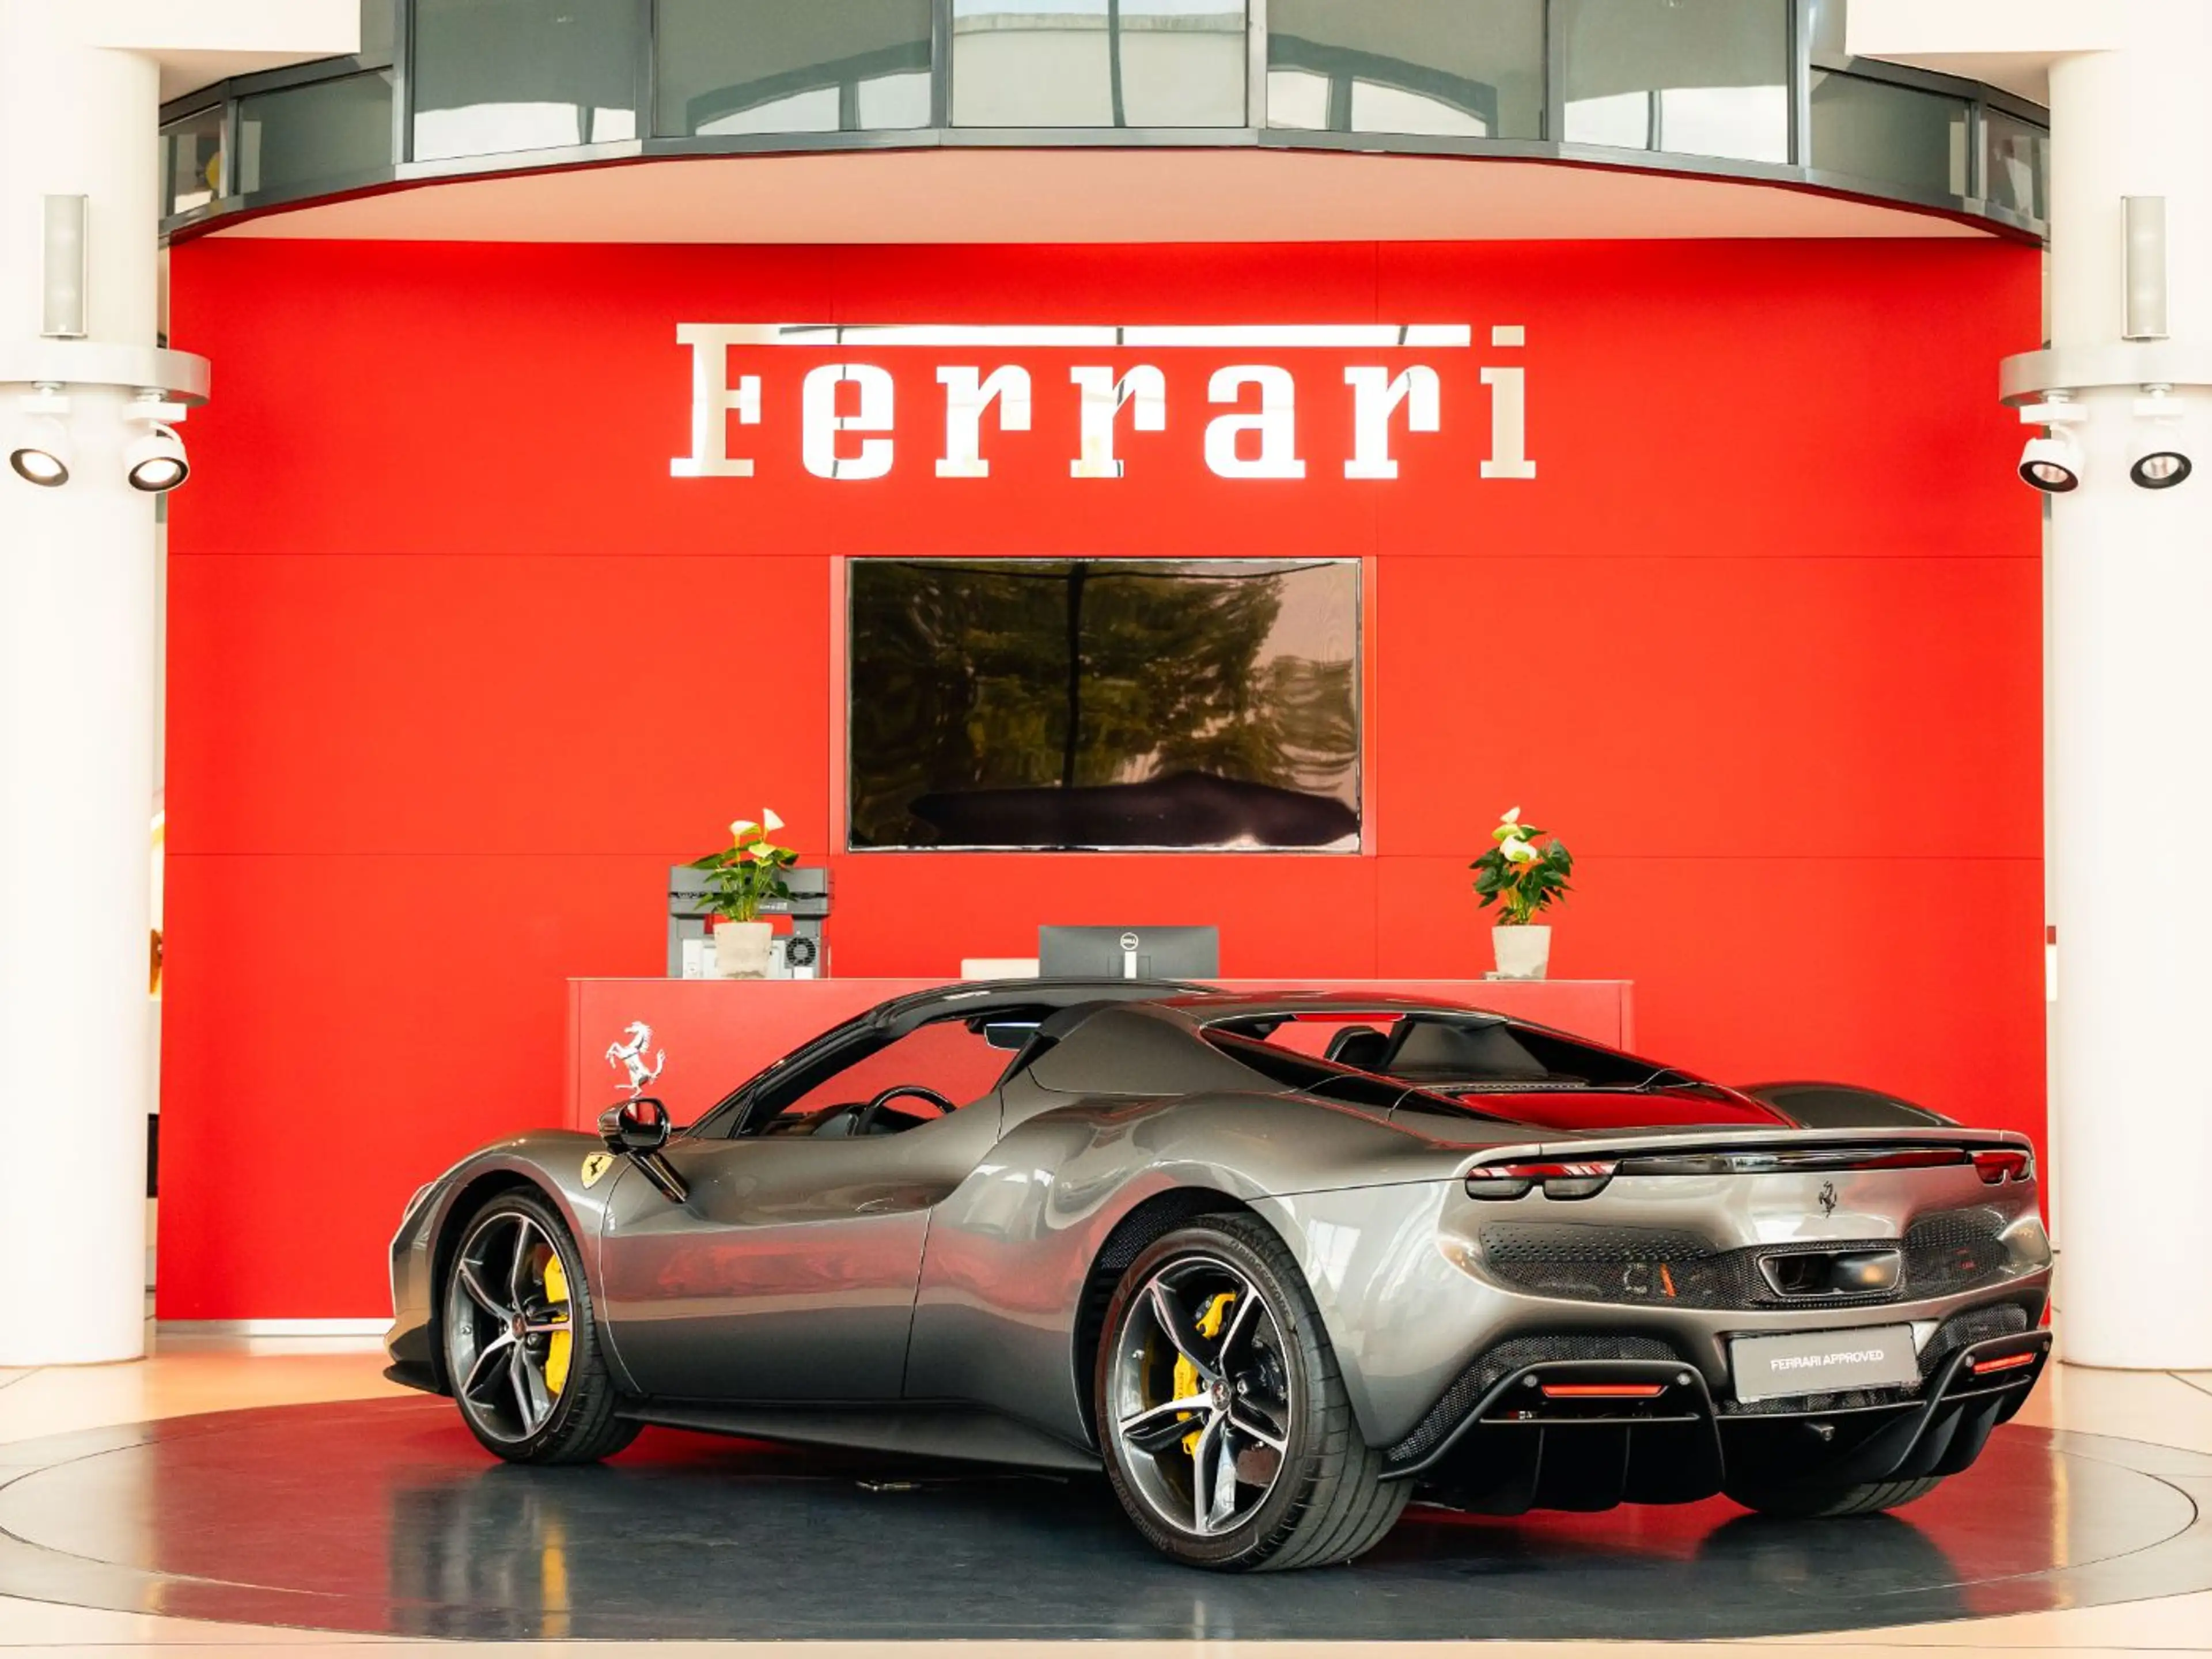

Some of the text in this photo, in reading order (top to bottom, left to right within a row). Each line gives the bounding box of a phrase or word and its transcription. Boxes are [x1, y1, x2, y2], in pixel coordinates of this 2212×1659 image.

[670, 323, 1536, 480] Ferrari
[1770, 1350, 1884, 1371] FERRARI APPROVED
